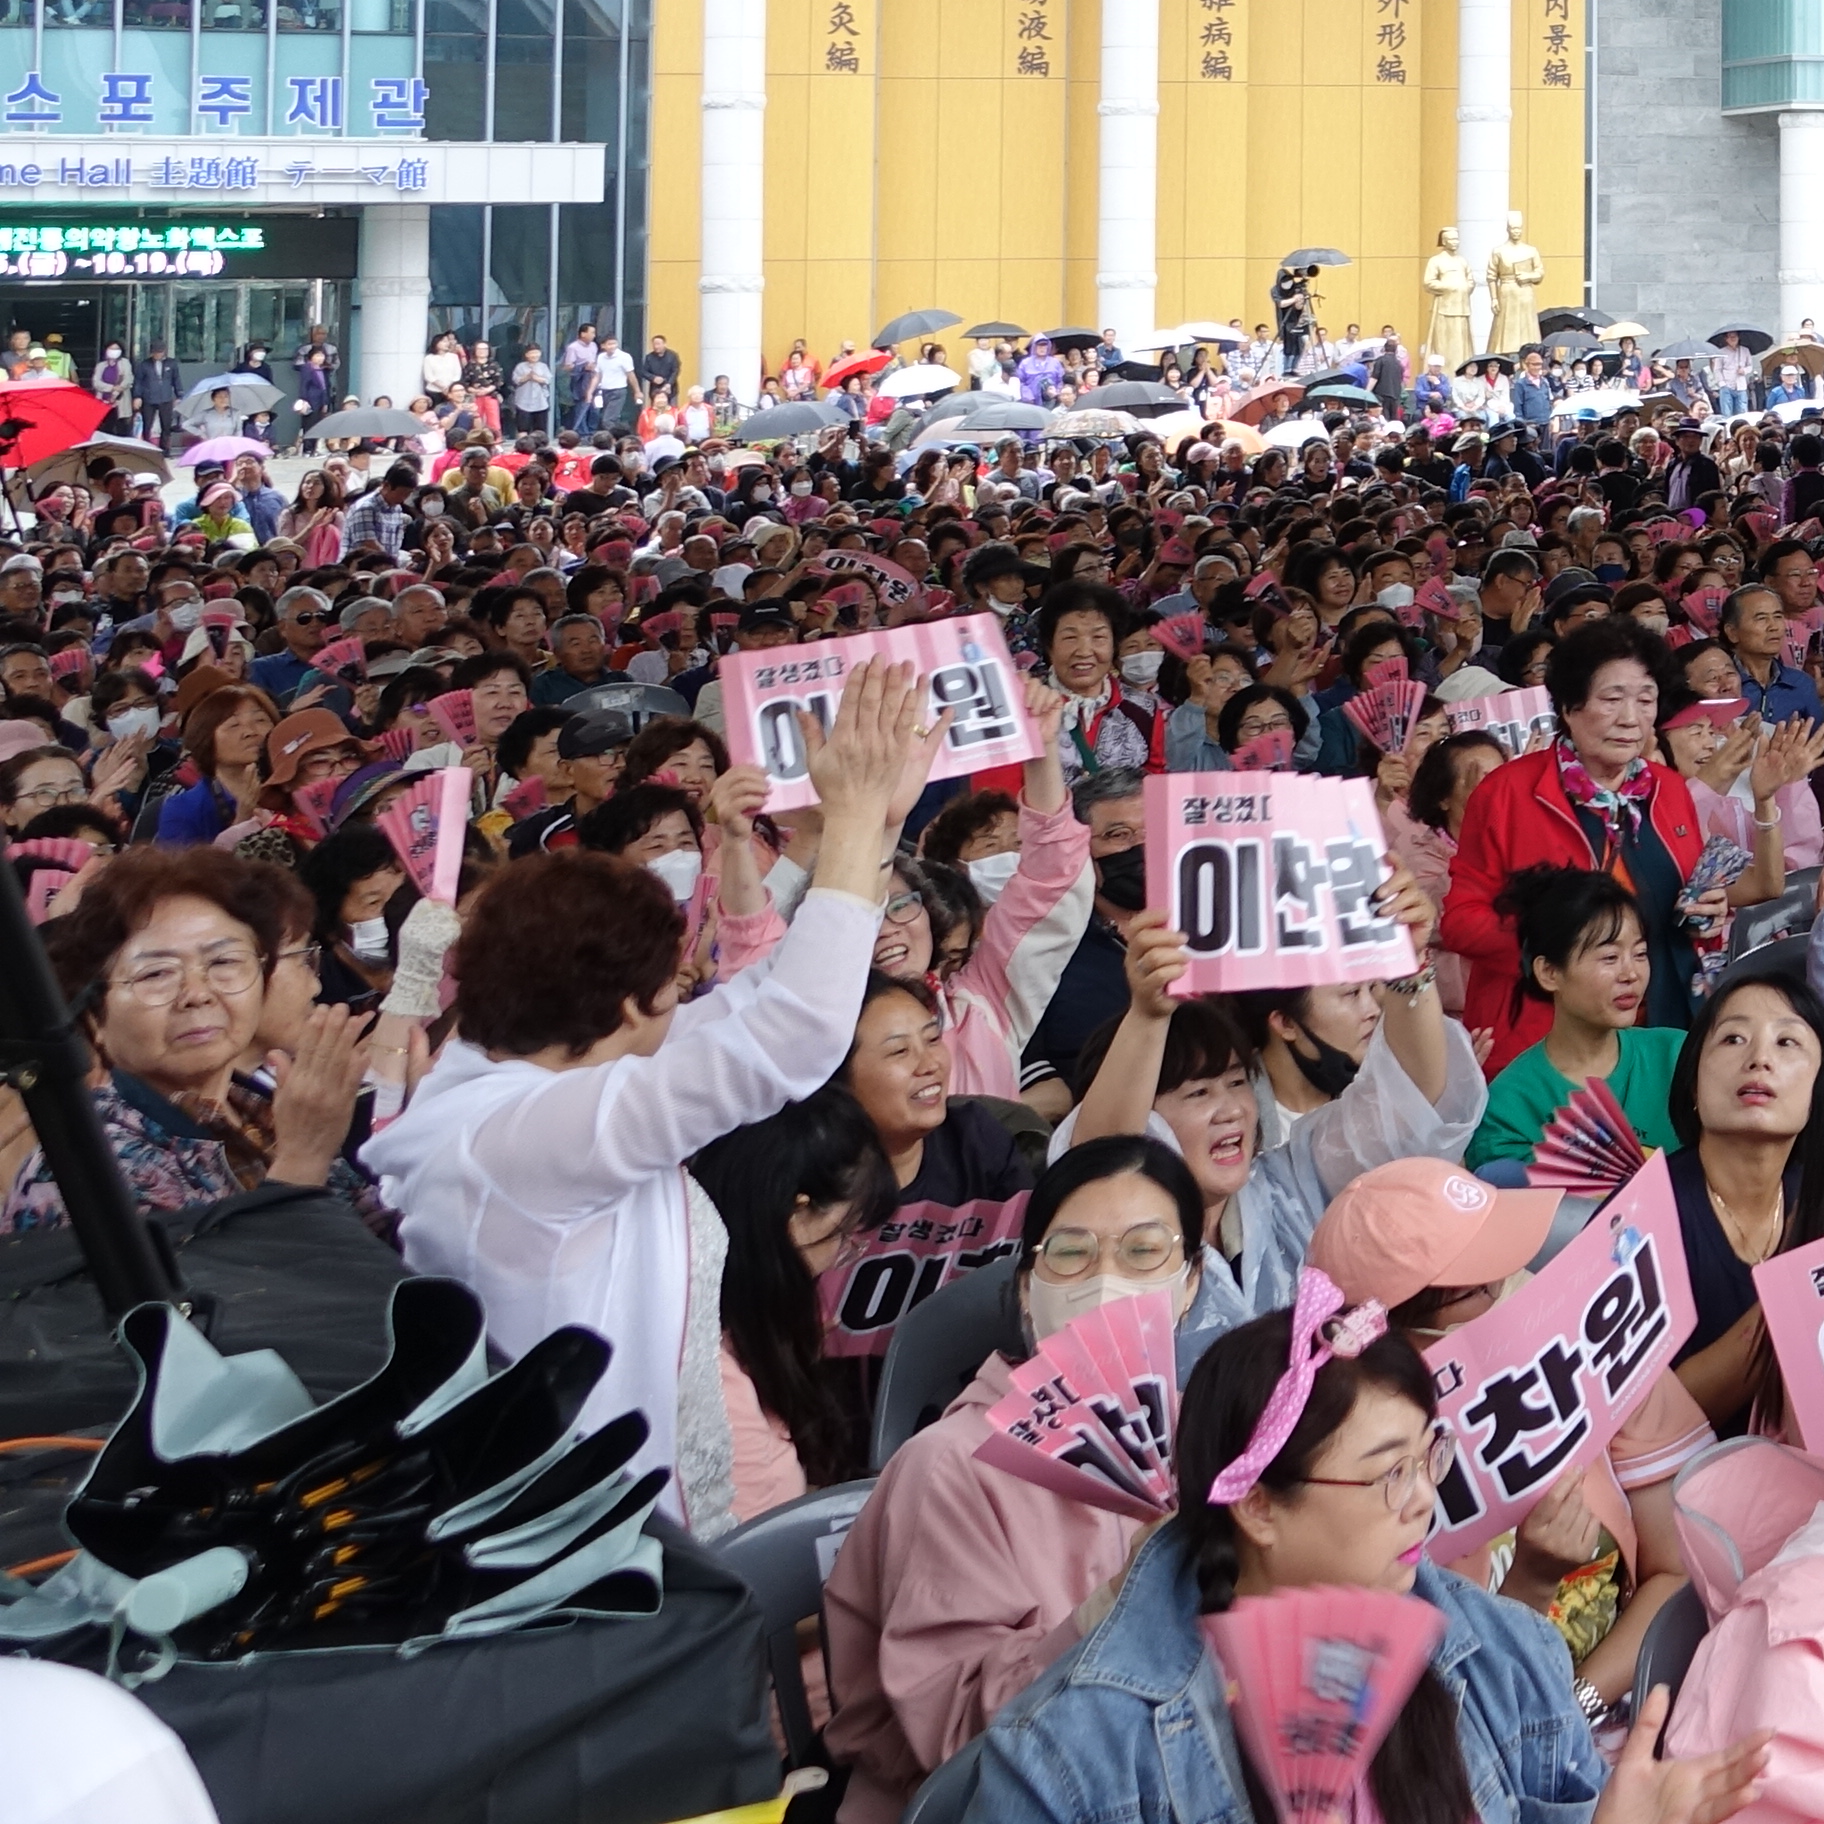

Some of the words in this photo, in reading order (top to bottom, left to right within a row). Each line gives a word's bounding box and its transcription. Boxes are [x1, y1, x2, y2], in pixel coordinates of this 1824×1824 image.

[60, 159, 131, 186] Hall
[150, 157, 259, 189] 主題館
[286, 158, 430, 190] テーマ館
[877, 1216, 985, 1244] 잘생겼다
